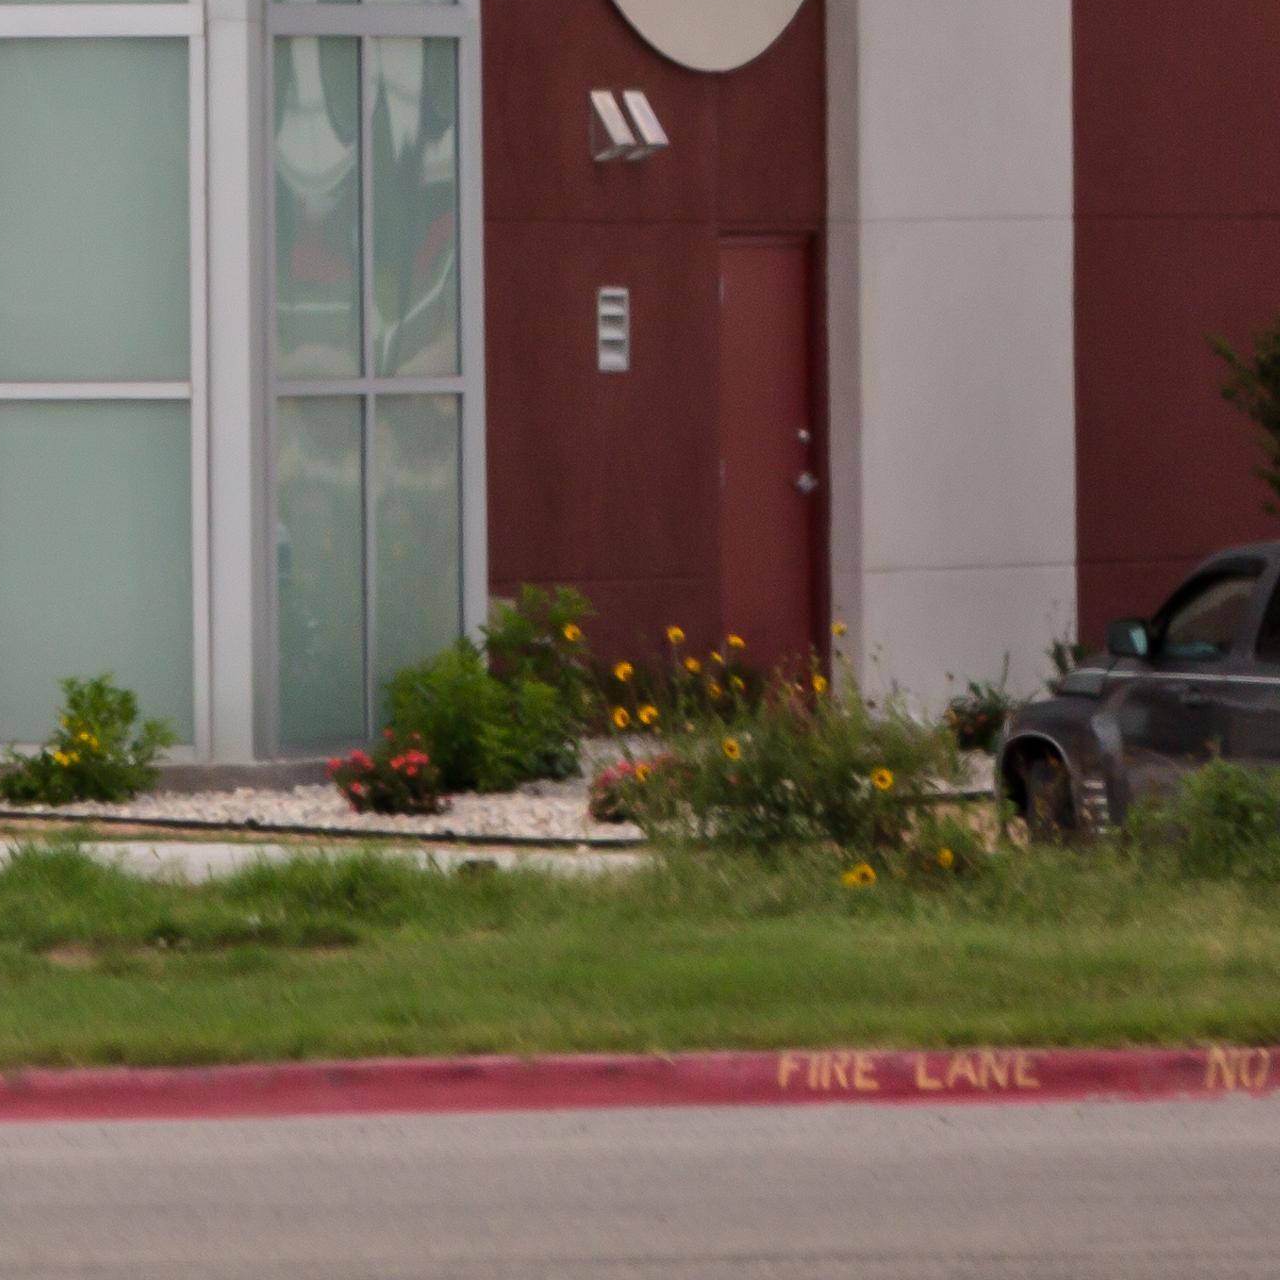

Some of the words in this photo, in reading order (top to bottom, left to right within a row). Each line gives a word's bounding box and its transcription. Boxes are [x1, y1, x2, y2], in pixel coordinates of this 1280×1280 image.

[777, 1049, 880, 1091] FIRE
[915, 1048, 1040, 1089] LANE
[1205, 1046, 1271, 1090] NO
